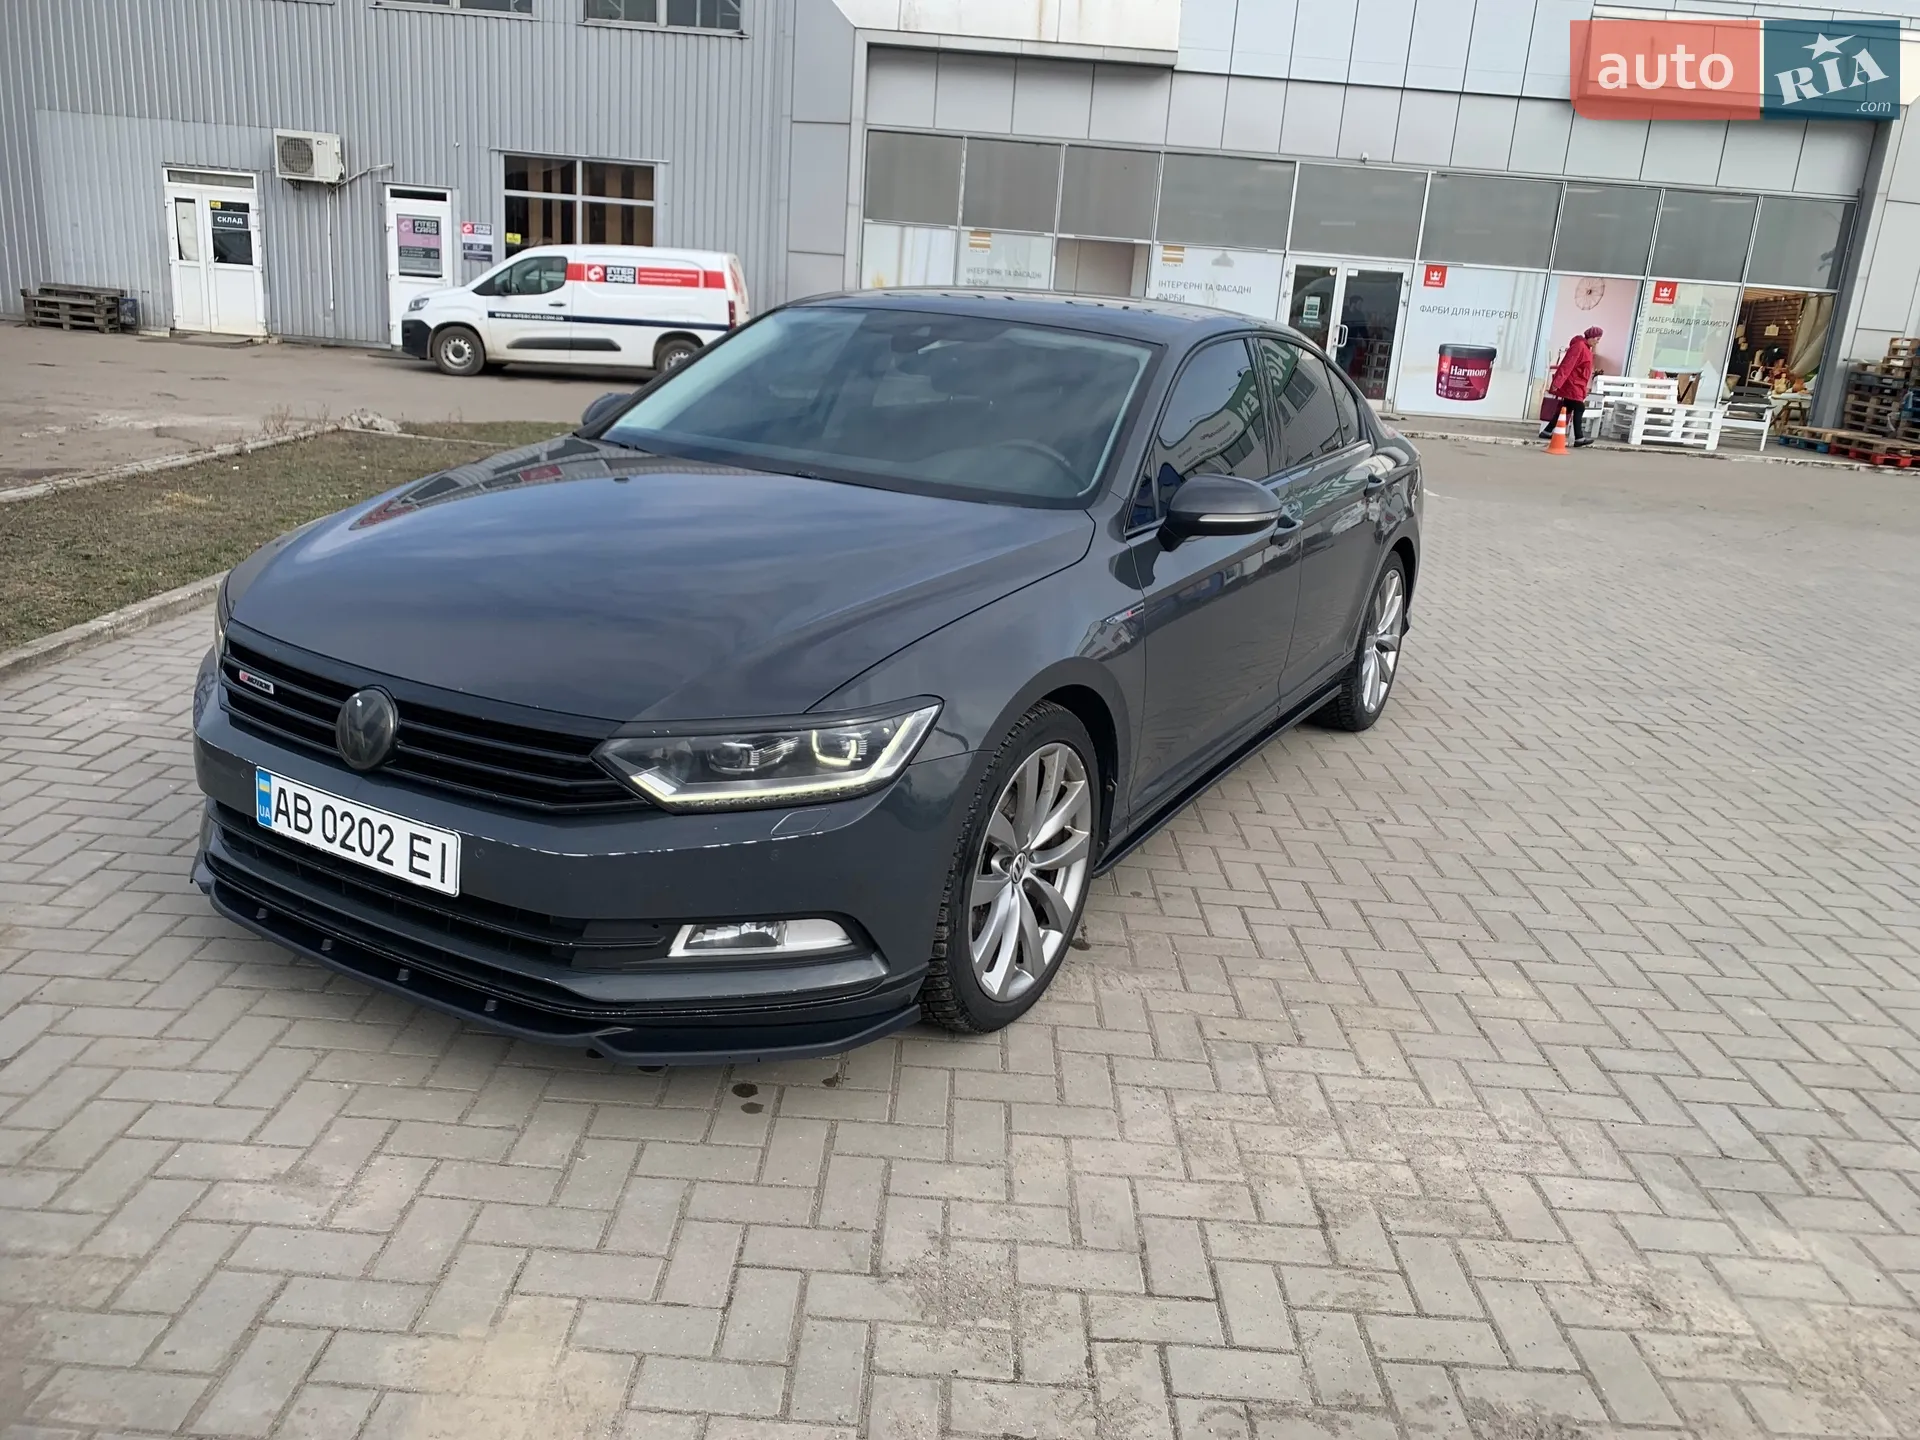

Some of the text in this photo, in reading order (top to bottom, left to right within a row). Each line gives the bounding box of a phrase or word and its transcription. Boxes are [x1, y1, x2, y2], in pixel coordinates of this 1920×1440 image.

[217, 216, 244, 225] СКЛАД
[414, 220, 438, 228] INTER
[414, 227, 438, 235] CARS
[606, 266, 635, 275] INTER
[606, 274, 635, 283] CARS
[1205, 283, 1214, 291] ТА
[1216, 284, 1252, 294] ФАСАДНІ
[1420, 305, 1450, 315] ФАРБИ
[1451, 307, 1470, 316] ДЛЯ
[1648, 316, 1685, 325] МАТЕРІАЛИ
[1645, 326, 1683, 335] ДЕРЕВИНИ
[1450, 365, 1488, 378] Harmony
[258, 804, 271, 819] UA
[274, 786, 447, 884] AB 0202 EI
